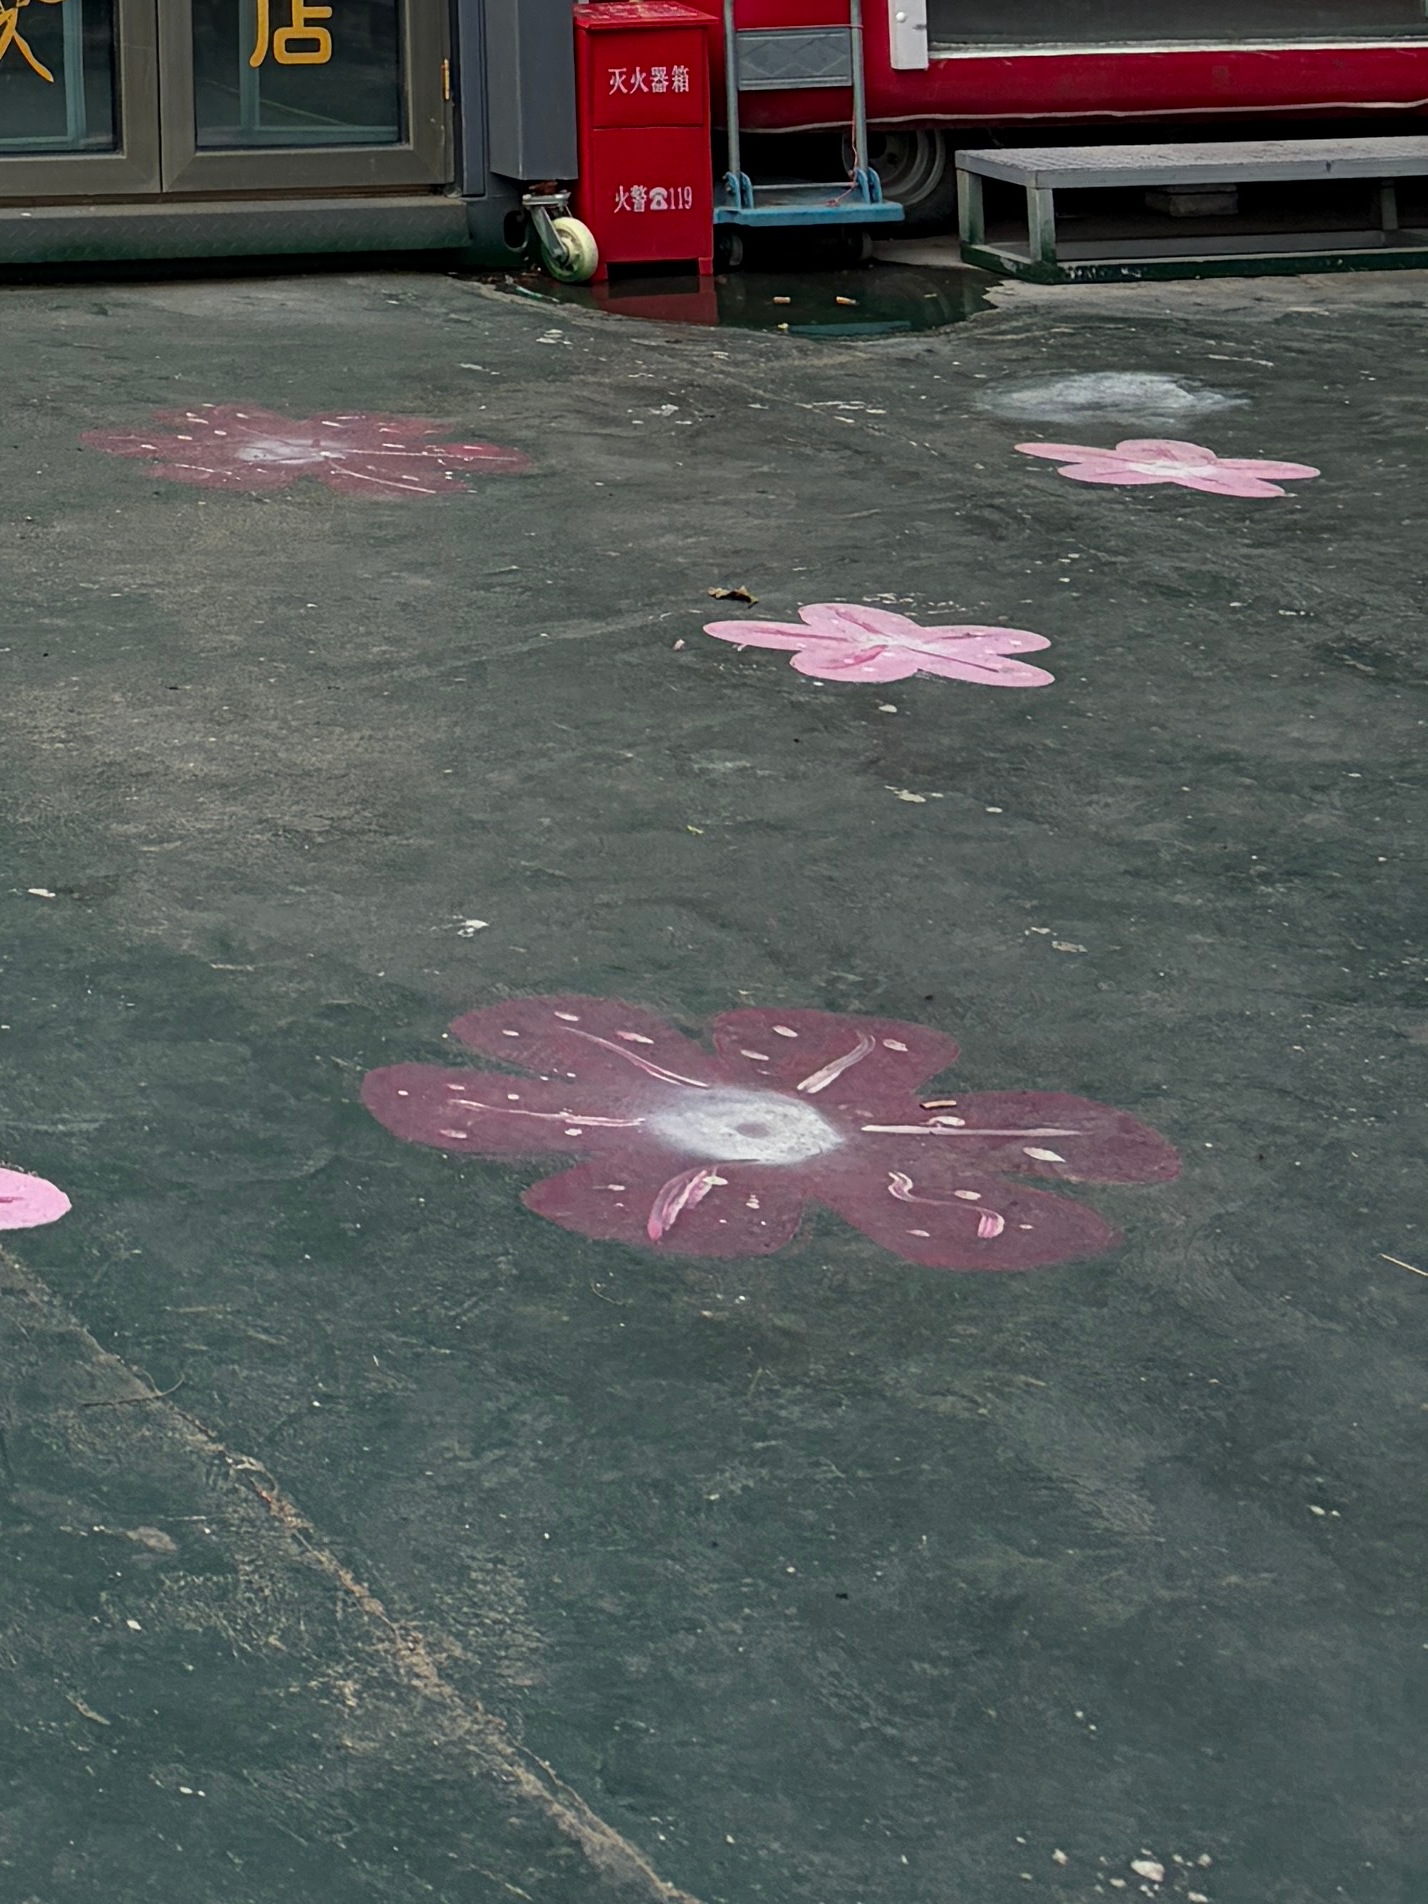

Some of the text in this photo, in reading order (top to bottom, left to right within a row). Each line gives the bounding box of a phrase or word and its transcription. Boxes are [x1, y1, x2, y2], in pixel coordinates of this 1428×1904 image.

[608, 65, 690, 95] 灭火器箱
[613, 184, 693, 214] 火警 119
